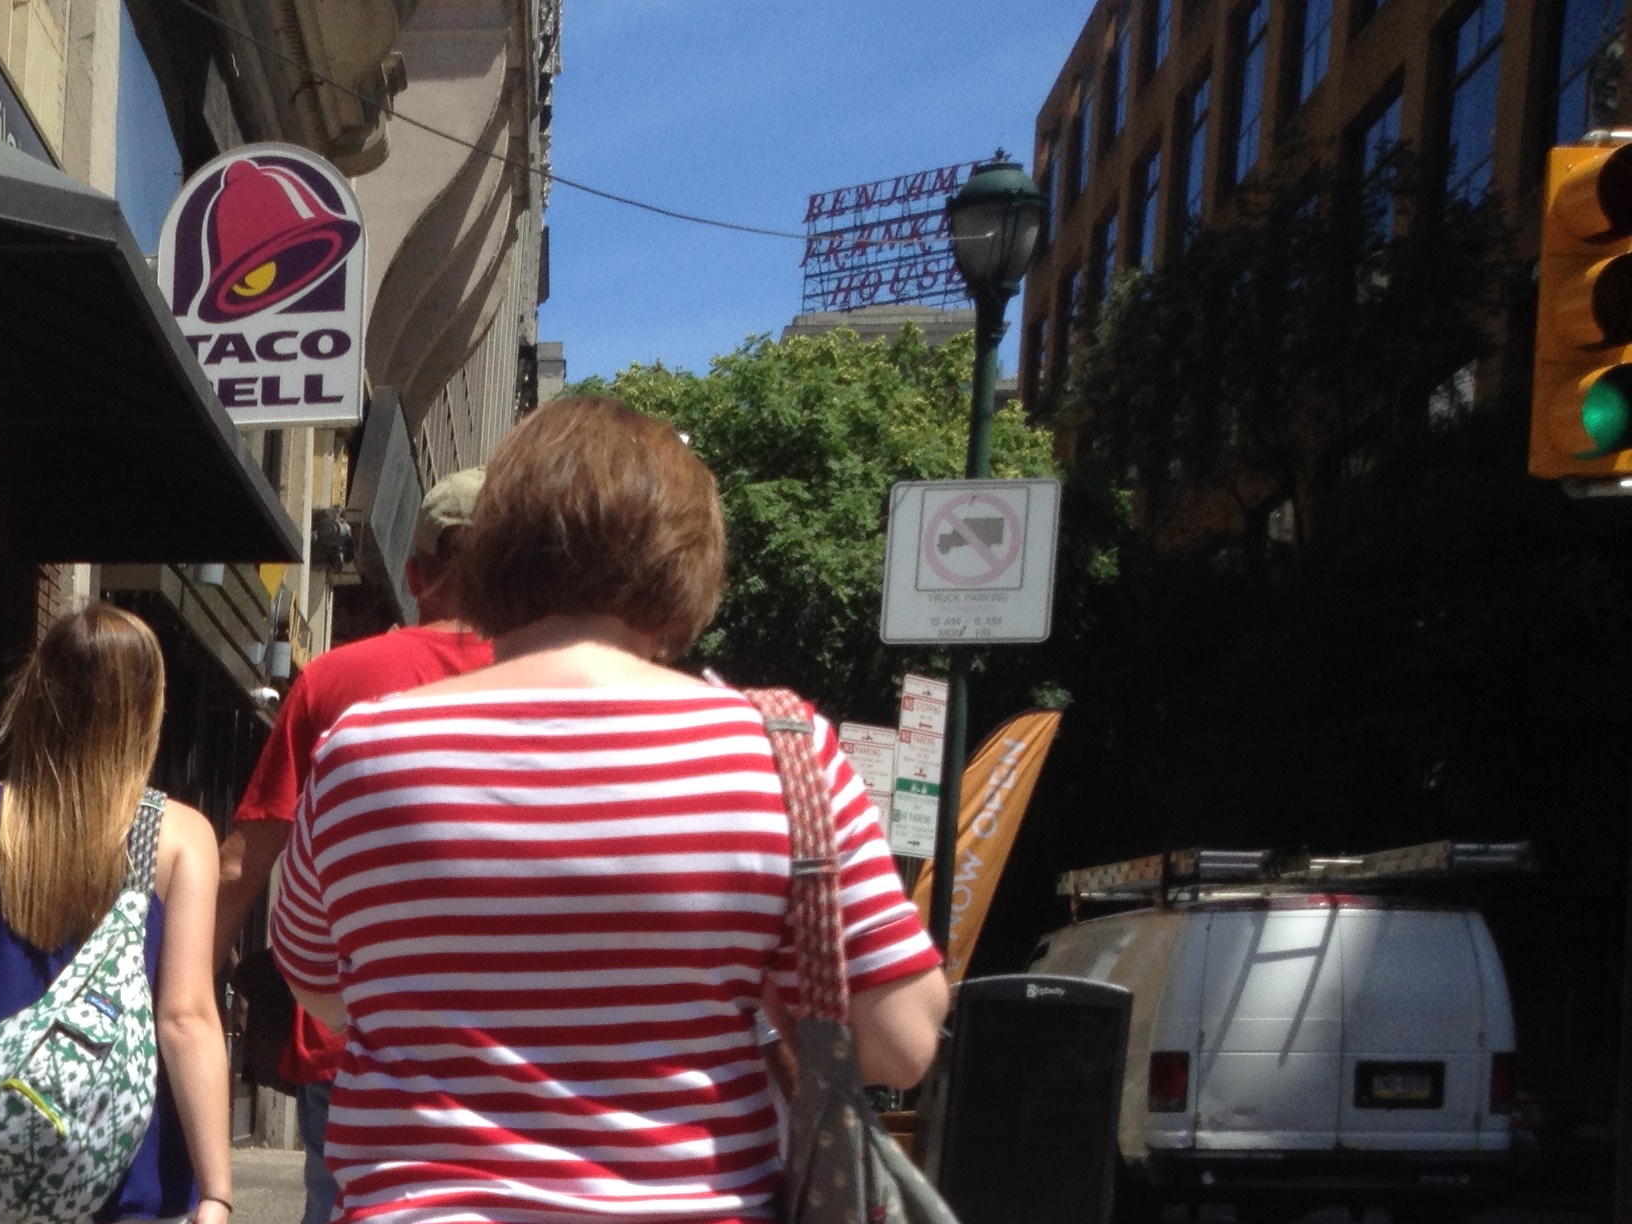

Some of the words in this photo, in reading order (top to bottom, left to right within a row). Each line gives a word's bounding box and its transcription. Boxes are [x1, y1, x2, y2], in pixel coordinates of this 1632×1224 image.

[802, 163, 979, 224] BENJAMI
[185, 328, 352, 365] TACO
[210, 374, 344, 408] ELL
[964, 593, 1008, 603] PARKING
[971, 738, 1028, 840] OPEN
